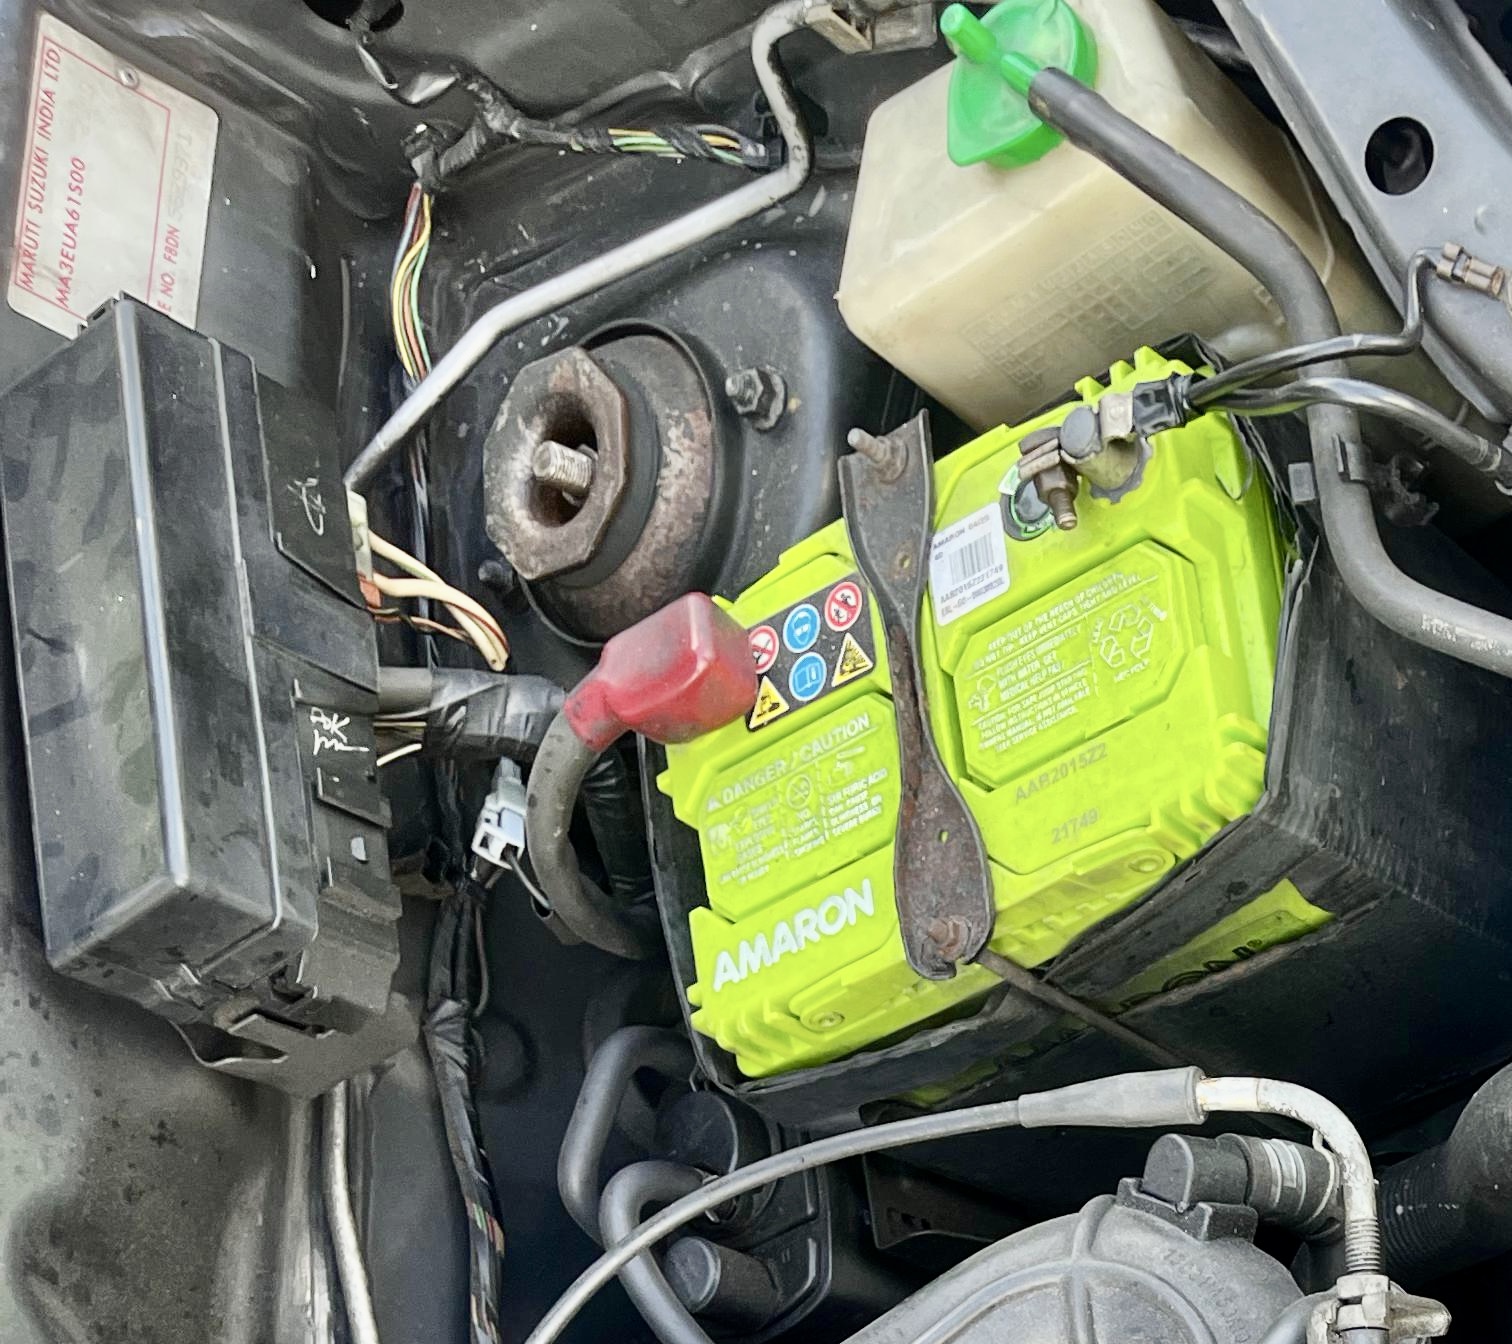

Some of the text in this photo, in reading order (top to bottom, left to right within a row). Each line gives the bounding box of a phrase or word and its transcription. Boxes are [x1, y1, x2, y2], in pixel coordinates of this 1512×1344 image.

[36, 87, 55, 140] INDIA
[28, 147, 48, 214] SUZUKI
[18, 219, 39, 289] MARUTI
[723, 757, 785, 805] DANGER
[801, 711, 869, 763] CAUTION
[712, 878, 876, 991] AMARON
